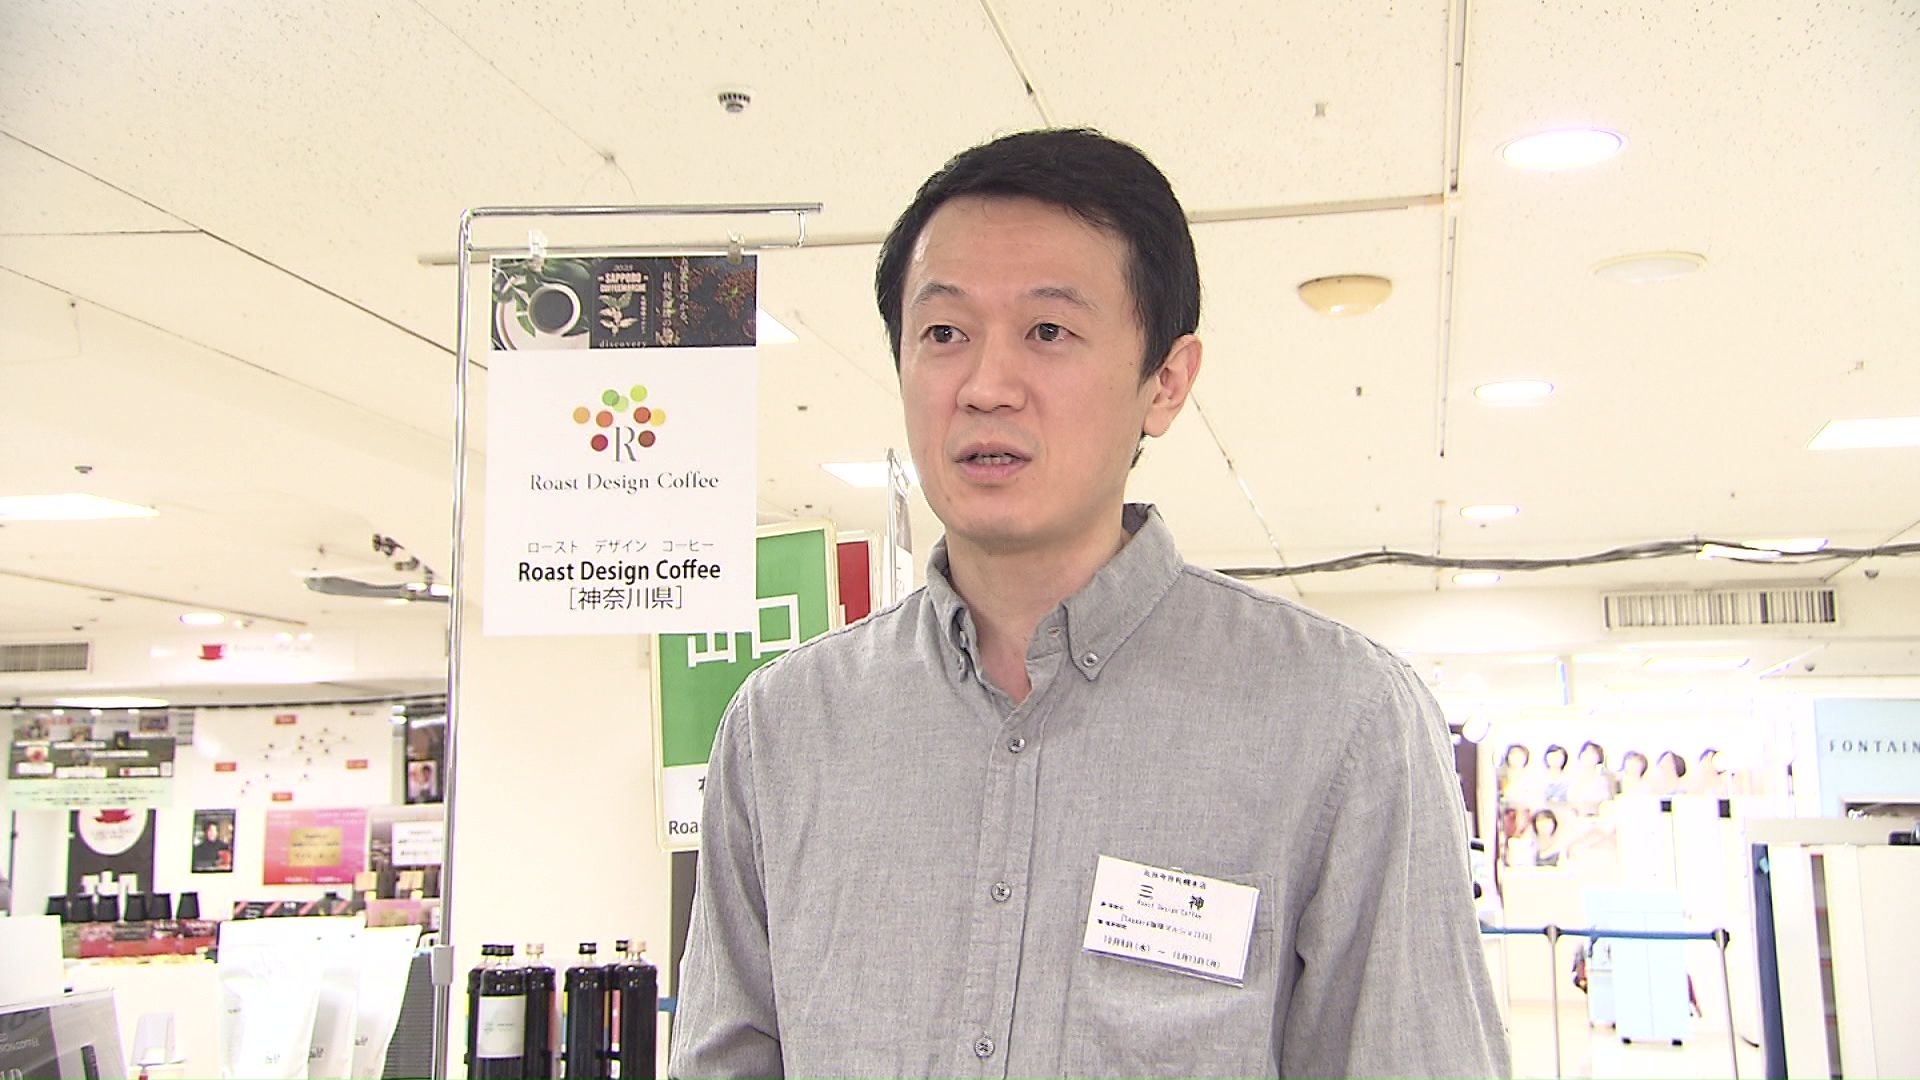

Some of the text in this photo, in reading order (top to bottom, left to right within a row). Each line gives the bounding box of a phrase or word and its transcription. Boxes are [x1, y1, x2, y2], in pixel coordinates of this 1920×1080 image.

[599, 339, 649, 349] discovery
[614, 426, 639, 462] R
[530, 471, 719, 495] Roast Design Coffee
[527, 539, 715, 554] ロースト デザイン コーヒー
[519, 558, 721, 585] Roast Design Coffee
[668, 820, 699, 835] Roa
